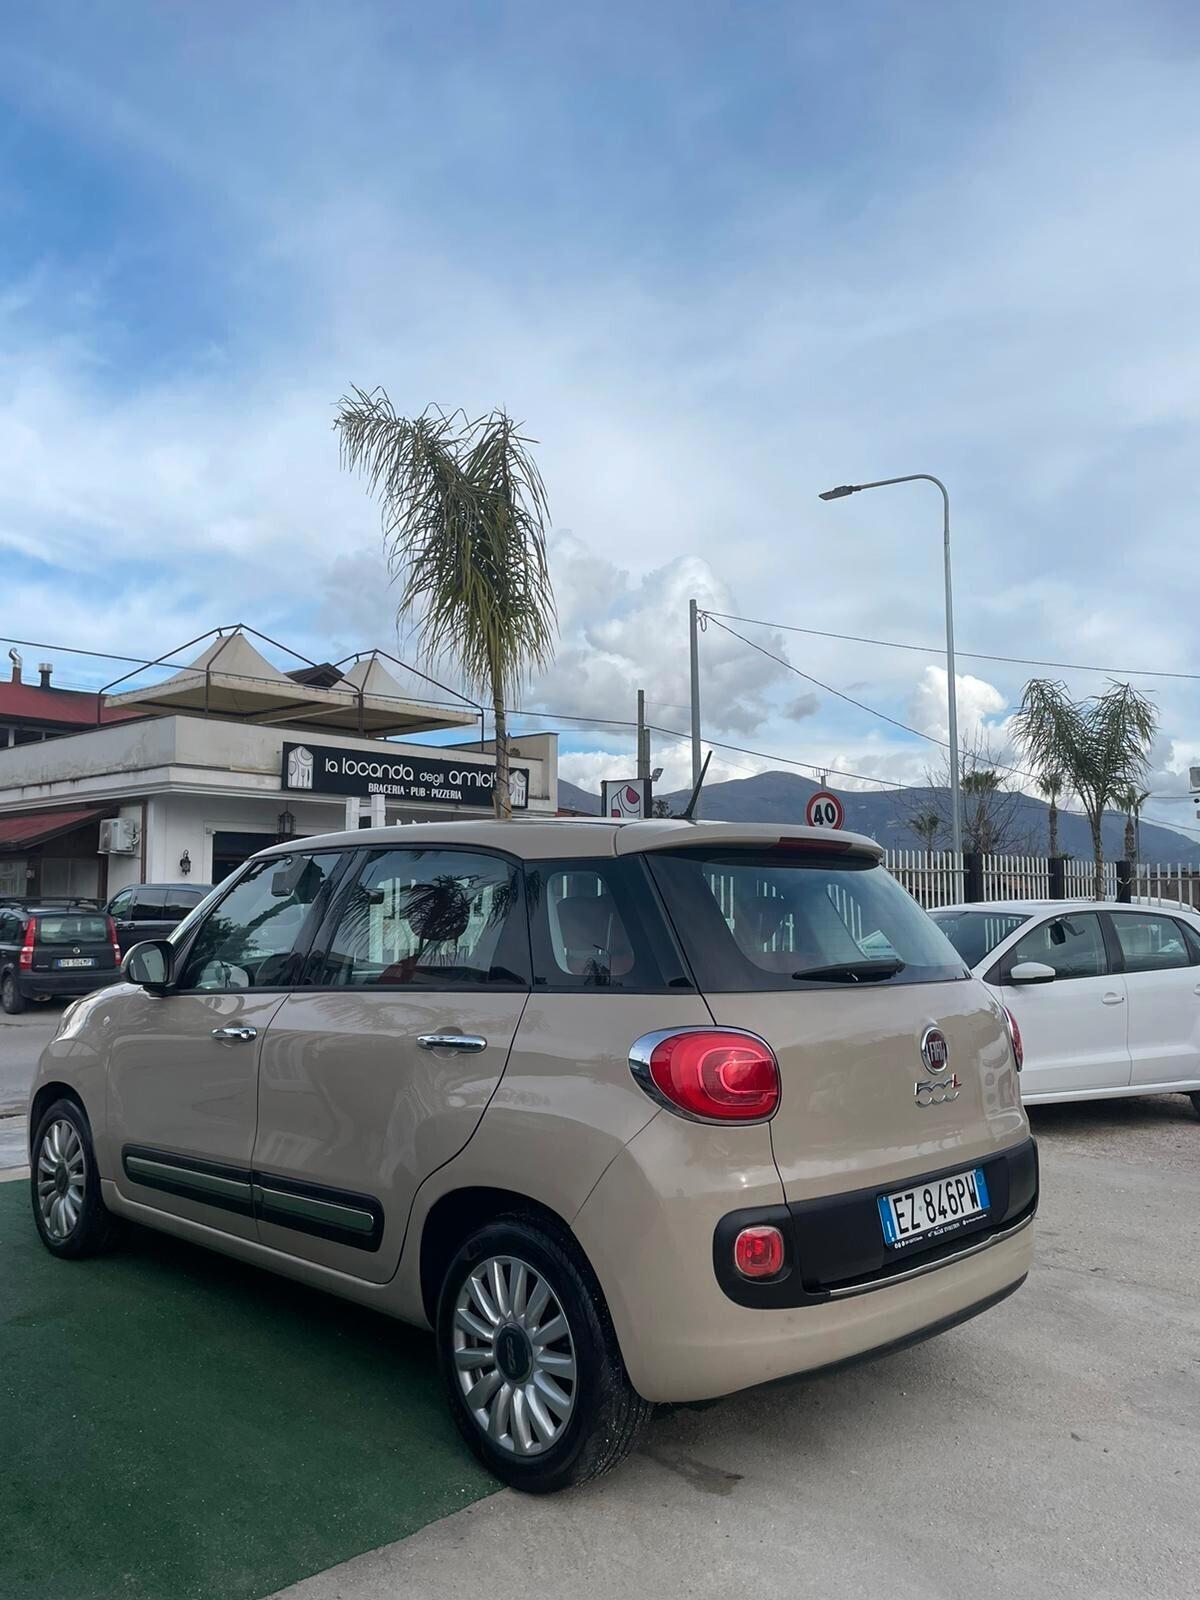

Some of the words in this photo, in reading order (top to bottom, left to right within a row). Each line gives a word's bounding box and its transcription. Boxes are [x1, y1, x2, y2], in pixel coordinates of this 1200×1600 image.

[325, 758, 338, 773] la
[342, 757, 414, 781] locanda
[420, 771, 445, 786] degli
[368, 783, 405, 795] BRACERIA
[410, 786, 426, 797] PUB
[431, 789, 463, 800] PIZZERIA
[814, 803, 835, 825] 40
[928, 1040, 947, 1062] FIAT
[893, 1192, 921, 1235] EZ
[923, 1174, 979, 1224] 846PW
